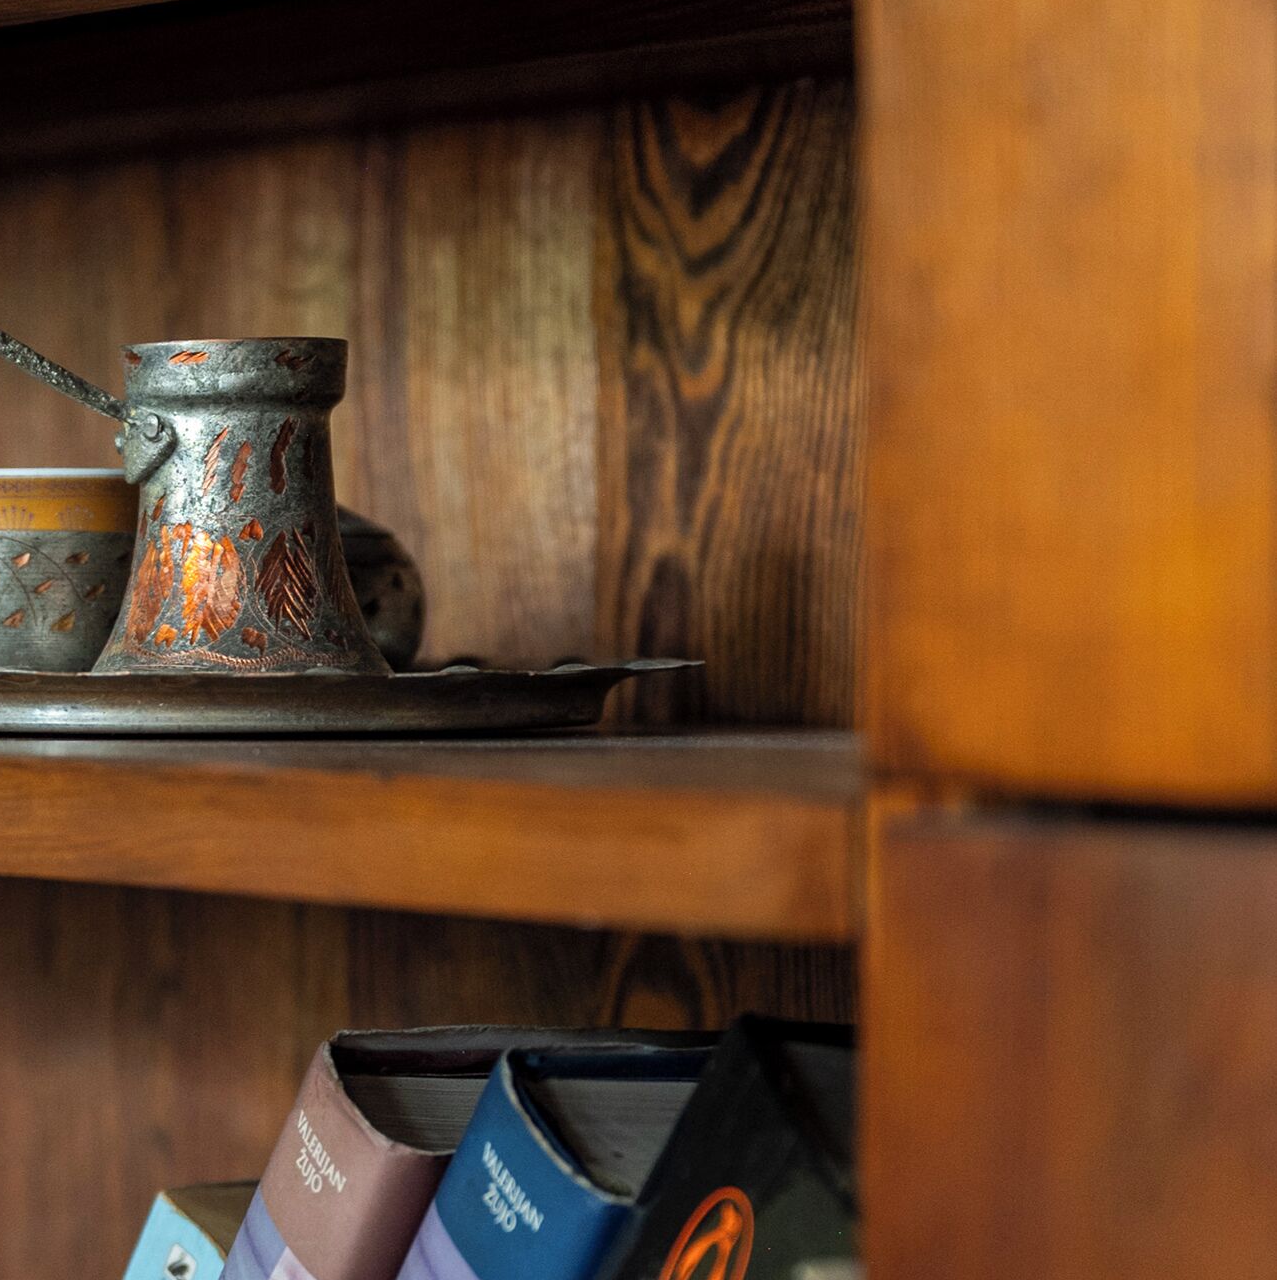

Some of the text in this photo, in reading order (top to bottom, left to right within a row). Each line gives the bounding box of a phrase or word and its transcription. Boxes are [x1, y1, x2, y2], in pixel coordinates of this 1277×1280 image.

[295, 1147, 323, 1194] ŽUJO
[297, 1109, 347, 1194] VALERIJAN
[482, 1140, 544, 1233] VALERIJAN
[482, 1181, 518, 1233] ŽUJO
